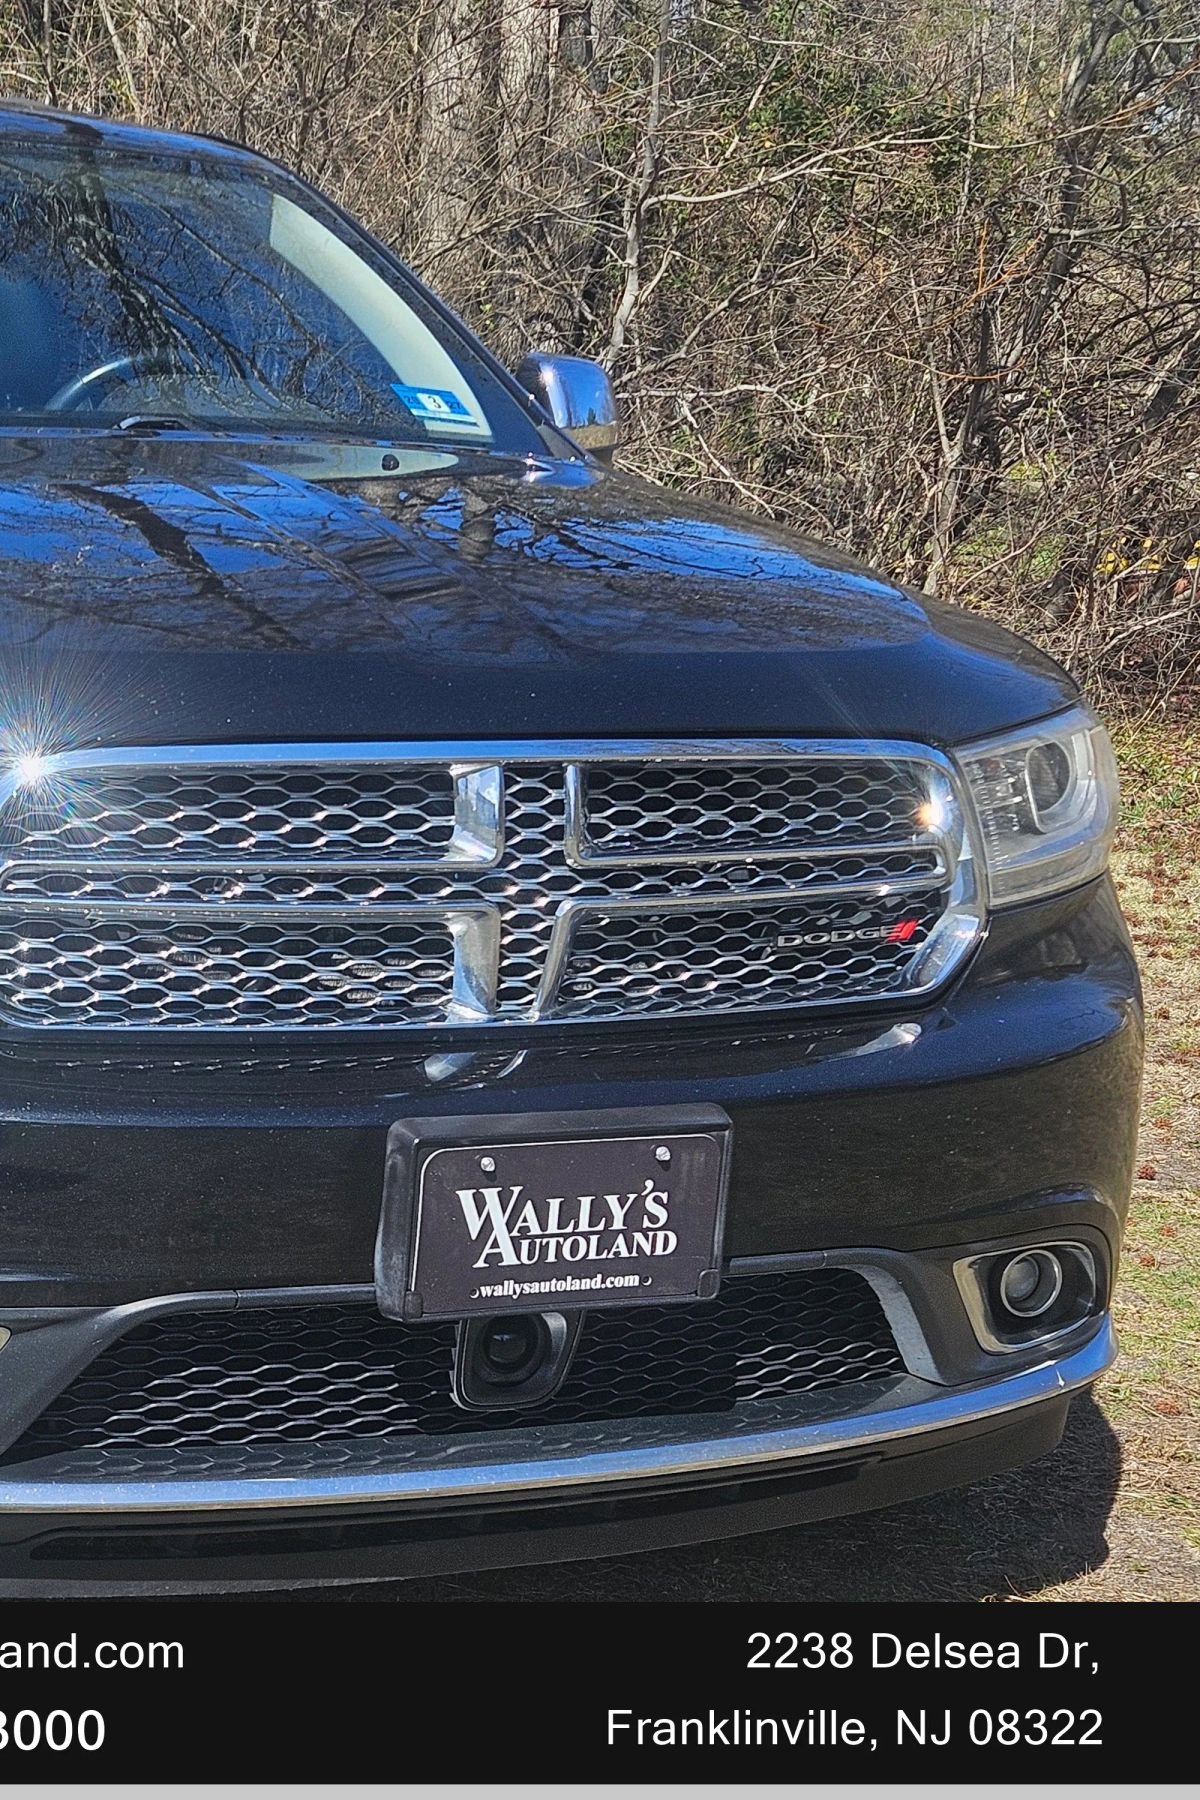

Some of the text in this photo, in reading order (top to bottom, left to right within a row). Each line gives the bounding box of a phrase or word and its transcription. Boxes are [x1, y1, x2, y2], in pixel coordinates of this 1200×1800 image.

[777, 925, 895, 948] DODGE
[455, 1178, 669, 1241] WALLY'S
[472, 1230, 678, 1269] AUTOLAND
[479, 1272, 641, 1301] wallysautoland.com
